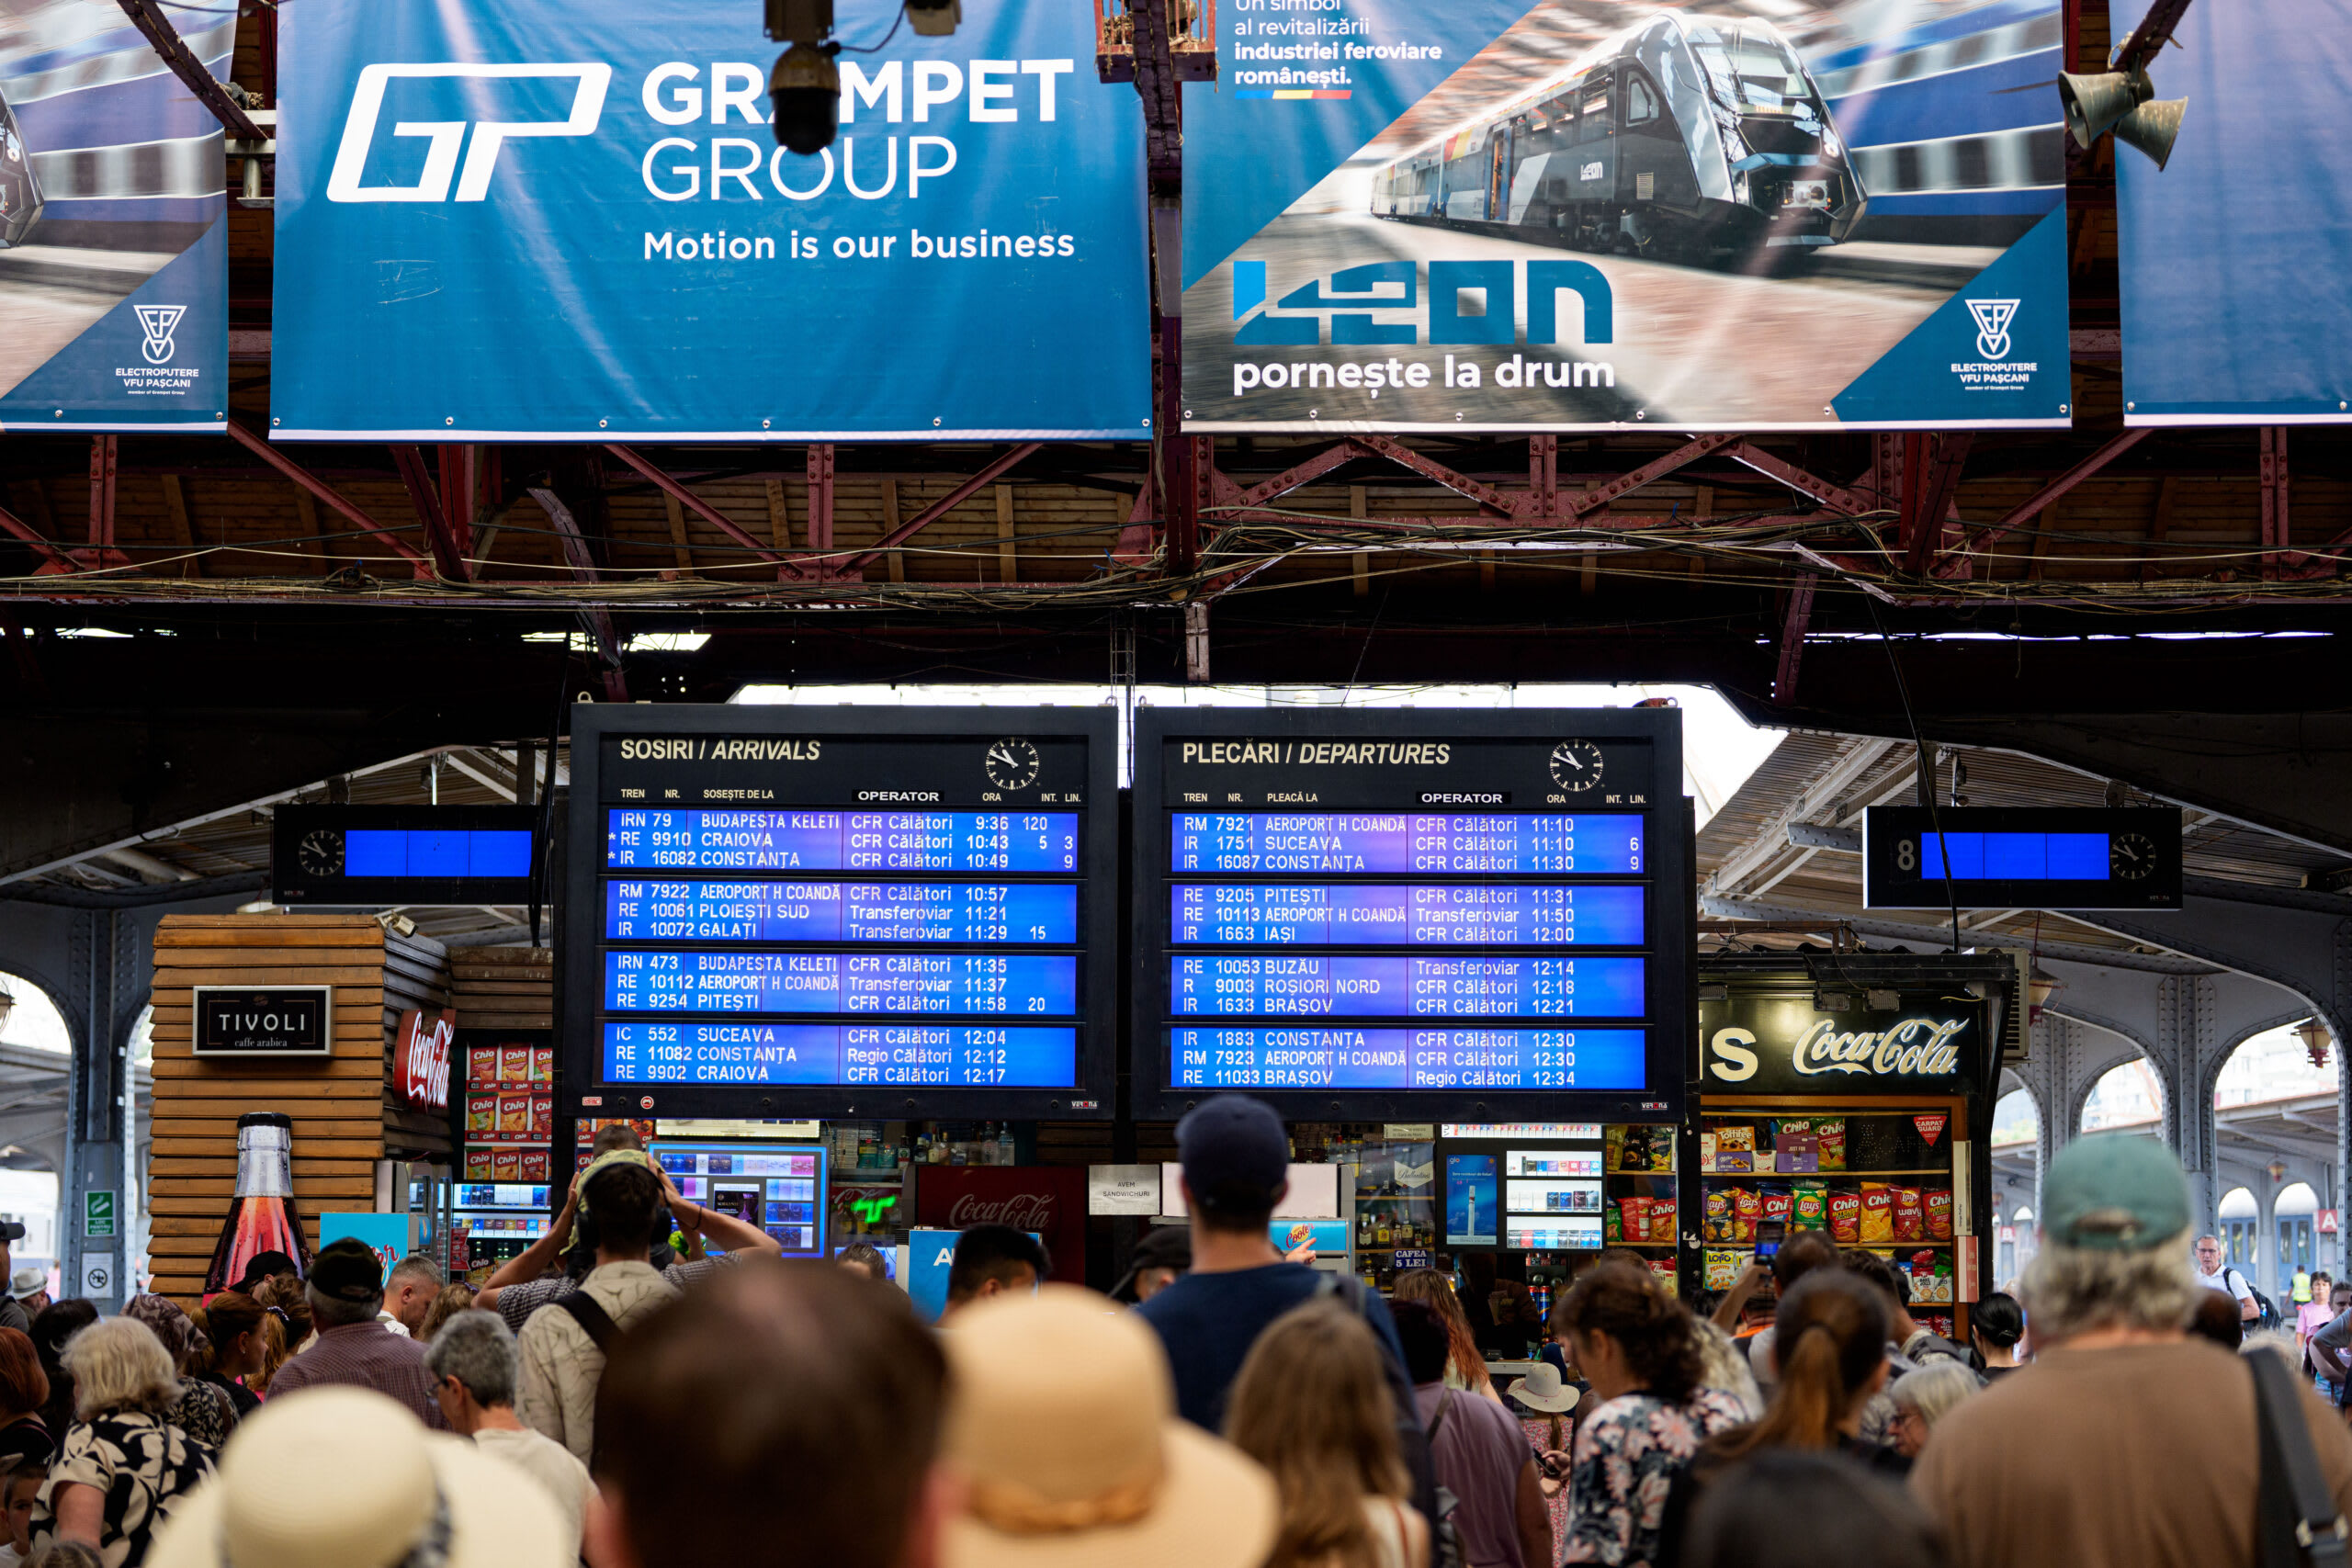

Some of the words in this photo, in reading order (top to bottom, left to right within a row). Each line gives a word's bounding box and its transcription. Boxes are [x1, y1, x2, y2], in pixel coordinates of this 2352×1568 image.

[1234, 18, 1252, 35] al
[1259, 17, 1370, 35] revitalizării
[1234, 42, 1339, 60] industriei
[1344, 42, 1442, 60] feroviare
[1234, 66, 1351, 89] românești.
[641, 58, 1074, 126] GRMPET
[326, 62, 612, 202] GP
[641, 135, 958, 201] GROUP
[643, 231, 776, 260] Motion
[790, 231, 819, 259] is
[831, 235, 897, 259] our
[910, 229, 1075, 258] business
[116, 367, 199, 378] ELECTROPUTERE
[1951, 363, 2038, 373] ELECTROPUTERE
[1233, 356, 1431, 399] pornește
[1445, 355, 1481, 388] la
[1494, 354, 1615, 389] drum
[1960, 374, 1981, 383] VFU
[1984, 374, 2030, 384] PAȘCANI
[124, 378, 143, 387] VFU
[146, 378, 191, 389] PAȘCANI
[620, 739, 693, 760] SOSIRI
[711, 739, 821, 761] ARRIVALS
[1182, 737, 1279, 763] PLECĂRI
[1298, 743, 1451, 764] DEPARTURES
[621, 789, 645, 798] TREN
[664, 789, 681, 798] NR.
[703, 789, 745, 801] SOSEȘTE
[747, 790, 761, 799] DE
[762, 790, 774, 799] LA
[857, 791, 939, 802] OPERATOR
[982, 793, 1001, 802] ORA
[1041, 793, 1057, 802] INT.
[1065, 794, 1081, 803] LIN.
[1183, 793, 1208, 802] TREN
[1227, 793, 1243, 802] NR.
[1267, 791, 1304, 803] PLEACĂ
[1306, 793, 1318, 803] LA
[1421, 793, 1503, 804] OPERATOR
[1546, 795, 1566, 804] ORA
[1606, 795, 1623, 804] INT.
[1630, 795, 1646, 804] LIN.
[622, 813, 645, 826] IRN
[653, 813, 671, 827] 79
[702, 814, 786, 828] BUDAPESTA
[792, 815, 839, 829] KELETI
[852, 816, 882, 829] CFR
[888, 815, 952, 829] Călători
[977, 817, 1008, 830] 9:36
[1023, 817, 1047, 830] 120
[1185, 818, 1206, 830] RM
[1216, 817, 1252, 830] 7921
[1266, 818, 1333, 831] AEROPORT
[1340, 818, 1346, 830] H
[1352, 817, 1406, 831] COANDĂ
[1416, 818, 1446, 831] CFR
[1453, 818, 1516, 831] Călători
[1532, 818, 1573, 831] 11:10
[621, 831, 639, 845] RE
[652, 832, 691, 846] 9910
[702, 832, 773, 847] CRAIOVA
[852, 834, 881, 847] CFR
[888, 834, 952, 849] Călători
[967, 835, 1008, 849] 10:43
[1040, 836, 1046, 849] 5
[1065, 836, 1072, 849] 3
[1897, 840, 1915, 871] 8
[1184, 888, 1203, 902] RE
[1216, 888, 1254, 902] 9205
[1265, 889, 1325, 905] PITEȘTI
[1416, 889, 1446, 903] CFR
[1453, 889, 1517, 903] Călători
[1532, 889, 1572, 903] 11:31
[619, 922, 632, 935] IR
[650, 922, 695, 936] 10072
[699, 923, 756, 939] GALAȚI
[850, 924, 953, 939] Transferoviar
[966, 926, 1007, 939] 11:29
[1030, 926, 1046, 940] 15
[1184, 979, 1193, 992] R
[1216, 979, 1254, 993] 9003
[1265, 979, 1329, 996] ROȘIORI
[1337, 980, 1380, 993] NORD
[1417, 980, 1446, 993] CFR
[1453, 979, 1517, 994] Călători
[1532, 980, 1574, 994] 12:18
[219, 1013, 305, 1031] TIVOLI
[617, 1027, 630, 1040] IC
[649, 1027, 676, 1041] 552
[698, 1028, 775, 1042] SUCEAVA
[848, 1030, 878, 1043] CFR
[886, 1029, 949, 1043] Călători
[965, 1031, 1005, 1044] 12:04
[234, 1037, 254, 1047] caffe
[256, 1037, 288, 1047] arabica
[1792, 1018, 1970, 1076] Coca-Cola
[473, 1050, 495, 1060] Chio
[505, 1051, 526, 1060] Chio
[1184, 1070, 1203, 1083] RE
[1216, 1070, 1260, 1084] 11033
[1265, 1070, 1332, 1087] BRAȘOV
[1417, 1070, 1456, 1087] Regio
[1463, 1070, 1520, 1085] Călători
[1533, 1072, 1575, 1085] 12:34
[471, 1100, 493, 1111] Chio
[503, 1101, 526, 1111] Chio
[1782, 1121, 1810, 1134] Chio
[1819, 1122, 1845, 1136] Chio
[469, 1155, 490, 1165] Chio
[497, 1155, 517, 1165] Chio
[524, 1155, 544, 1165] Chio
[1833, 1199, 1859, 1211] Chio
[949, 1194, 1055, 1229] Coca-Cola
[1898, 1208, 1922, 1216] wavy
[2321, 1215, 2336, 1228] A
[1396, 1259, 1403, 1268] 5
[1406, 1259, 1426, 1268] LEI
